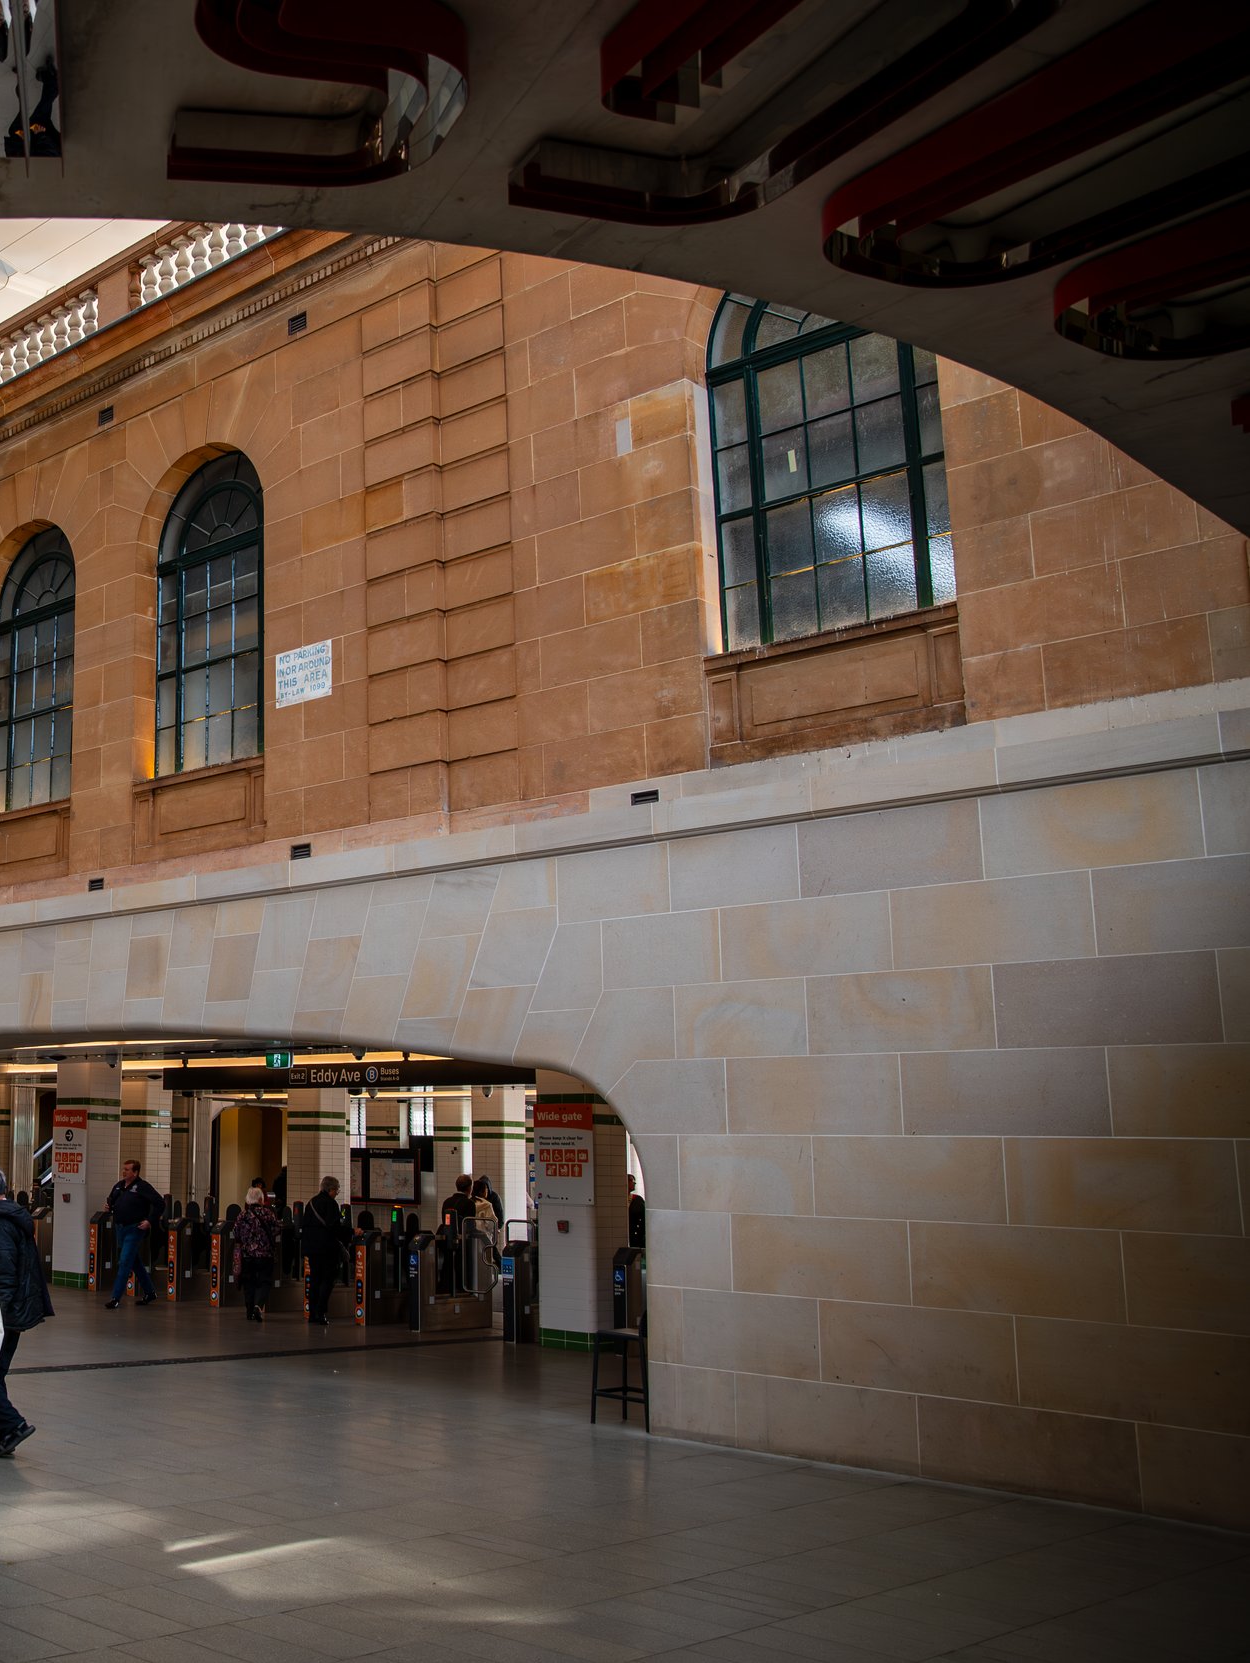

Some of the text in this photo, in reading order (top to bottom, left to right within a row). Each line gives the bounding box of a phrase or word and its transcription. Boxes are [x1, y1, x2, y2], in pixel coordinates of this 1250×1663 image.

[279, 645, 326, 665] NO PARKING
[277, 656, 330, 678] IN OR AROUND
[278, 669, 327, 690] THIS AREA
[280, 681, 326, 699] BY-LAW 1099
[290, 1072, 301, 1080] Exit
[301, 1072, 305, 1080] 2
[310, 1068, 338, 1085] Eddy
[339, 1068, 361, 1082] Ave
[380, 1067, 399, 1075] Buses
[69, 1115, 83, 1124] gate
[536, 1112, 583, 1123] Wide gate
